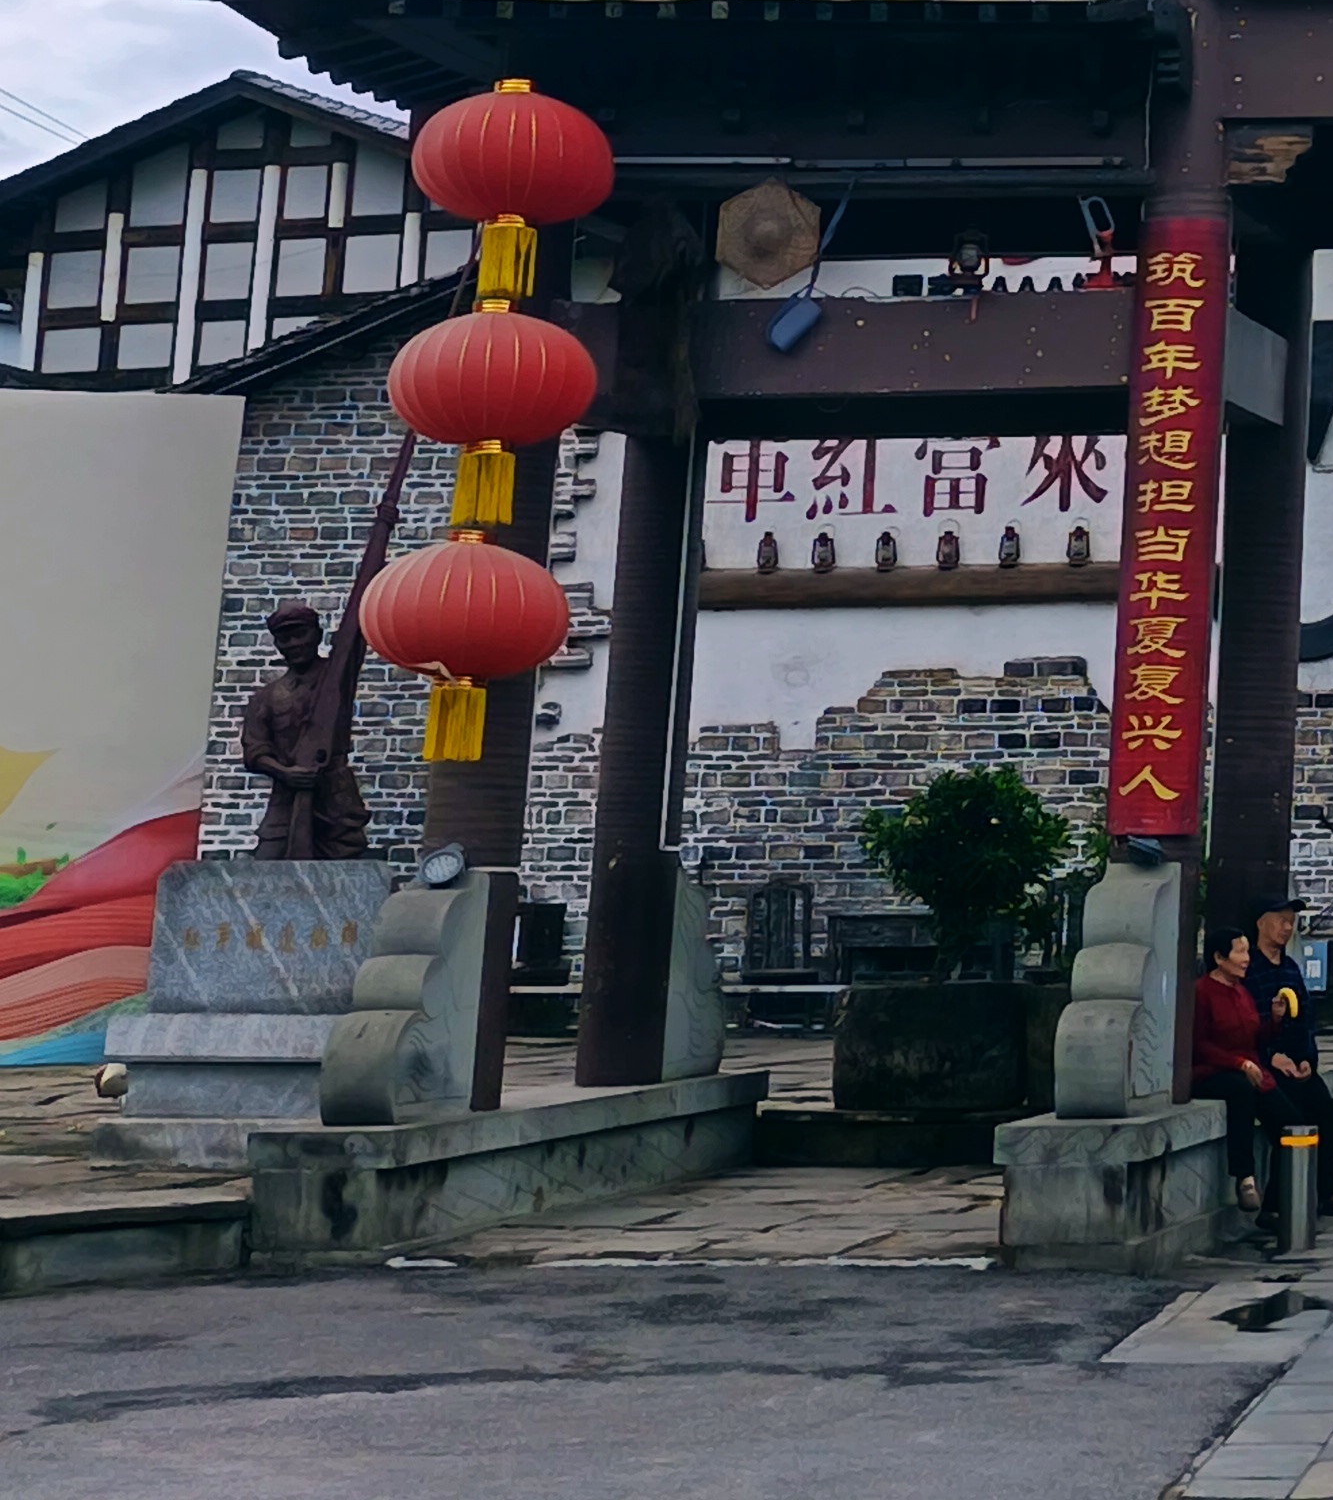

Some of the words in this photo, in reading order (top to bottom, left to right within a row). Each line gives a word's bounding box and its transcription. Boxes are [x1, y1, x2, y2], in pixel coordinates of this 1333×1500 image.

[1118, 252, 1207, 801] 筑百年梦想担当华夏复兴人
